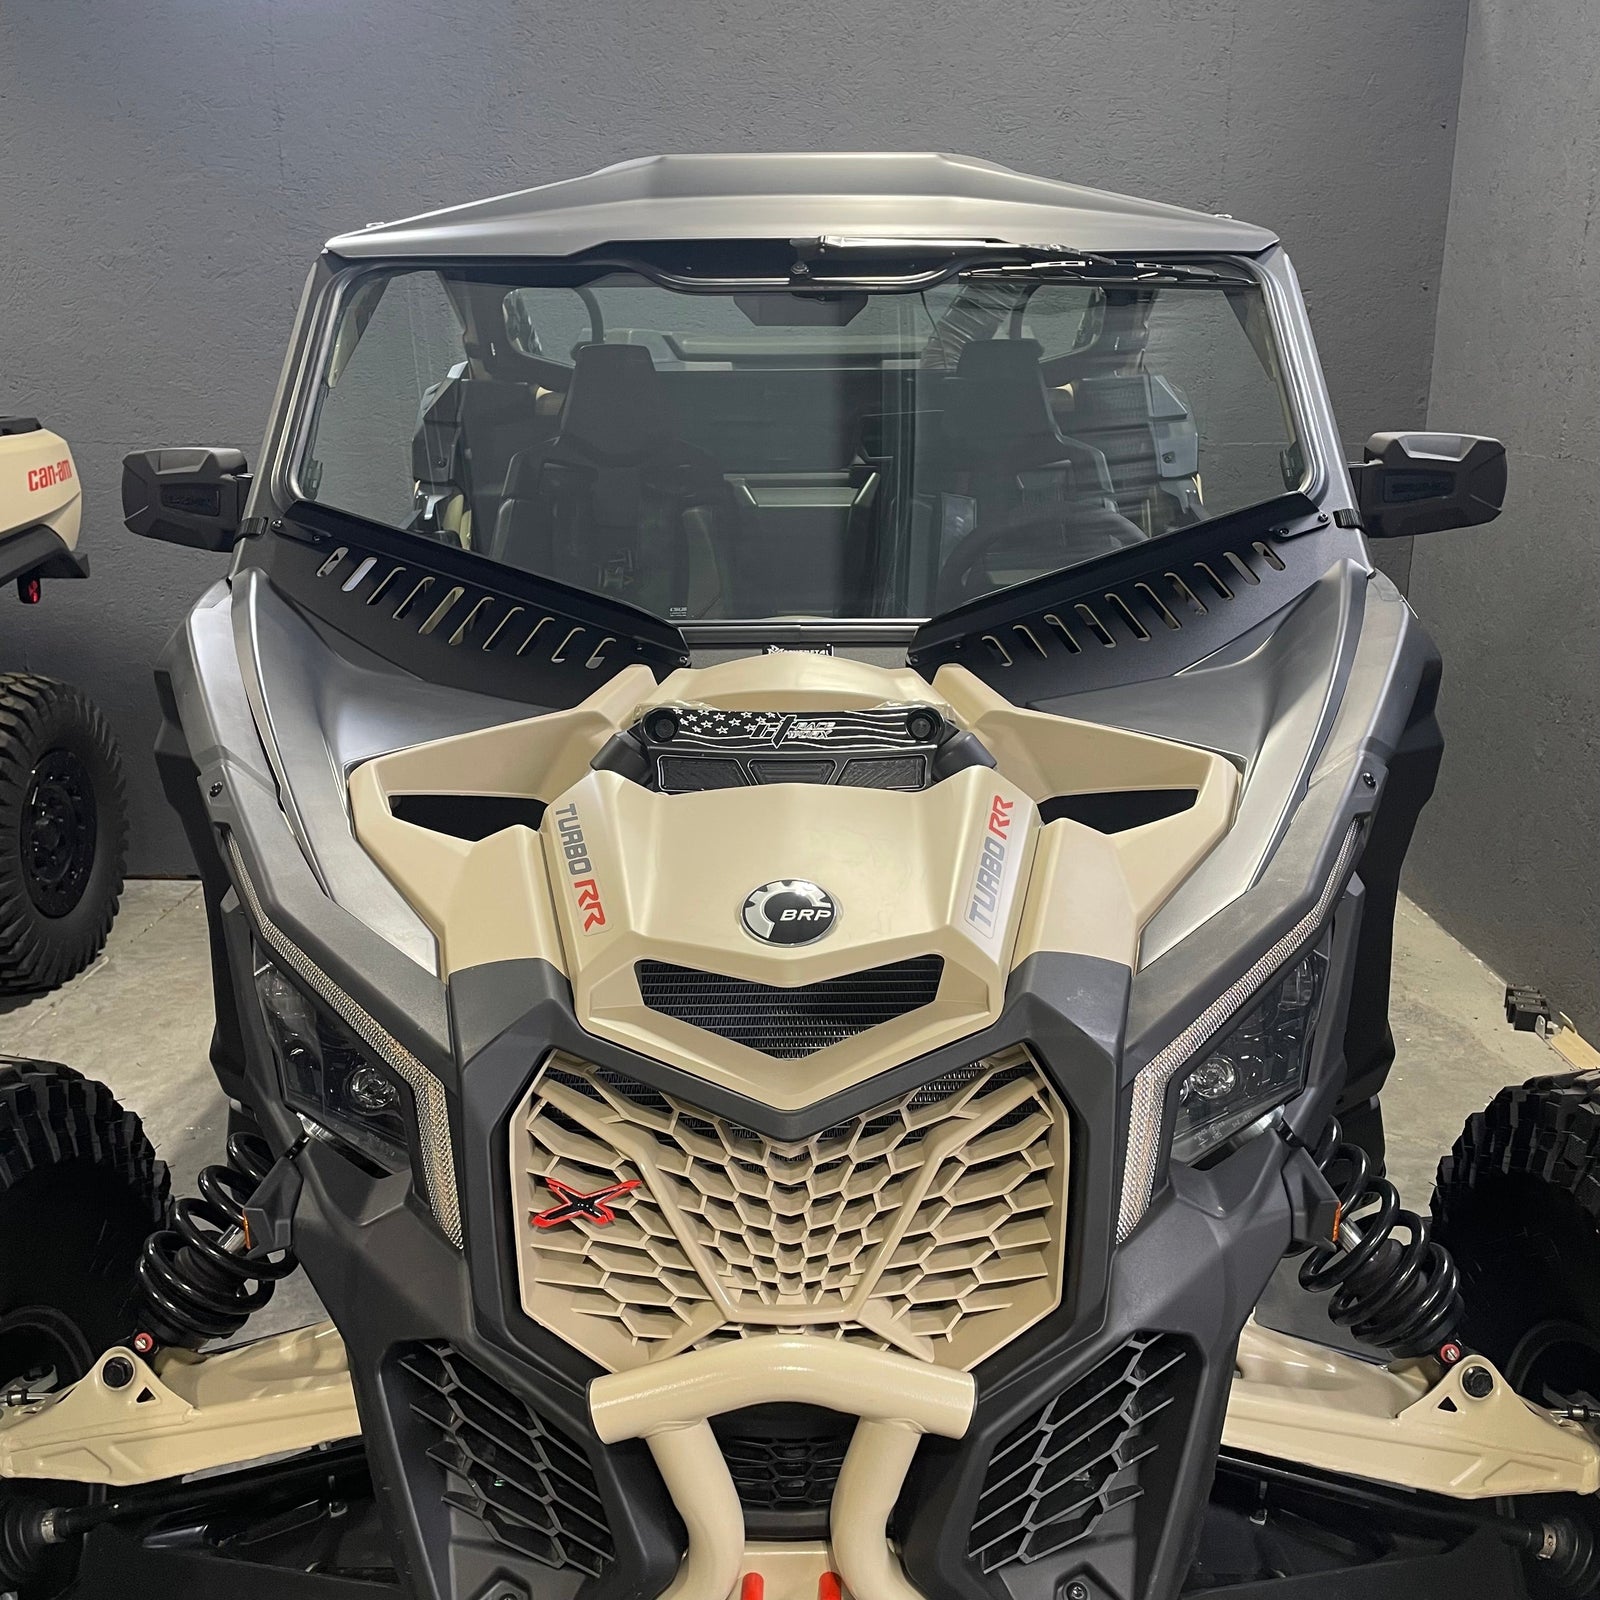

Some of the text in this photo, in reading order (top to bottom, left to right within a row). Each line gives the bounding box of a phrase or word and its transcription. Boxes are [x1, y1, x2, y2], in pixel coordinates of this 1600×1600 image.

[28, 460, 73, 492] can-am
[555, 802, 606, 933] TURBO RR
[968, 794, 1014, 928] TURBO RR
[779, 908, 832, 921] BRP
